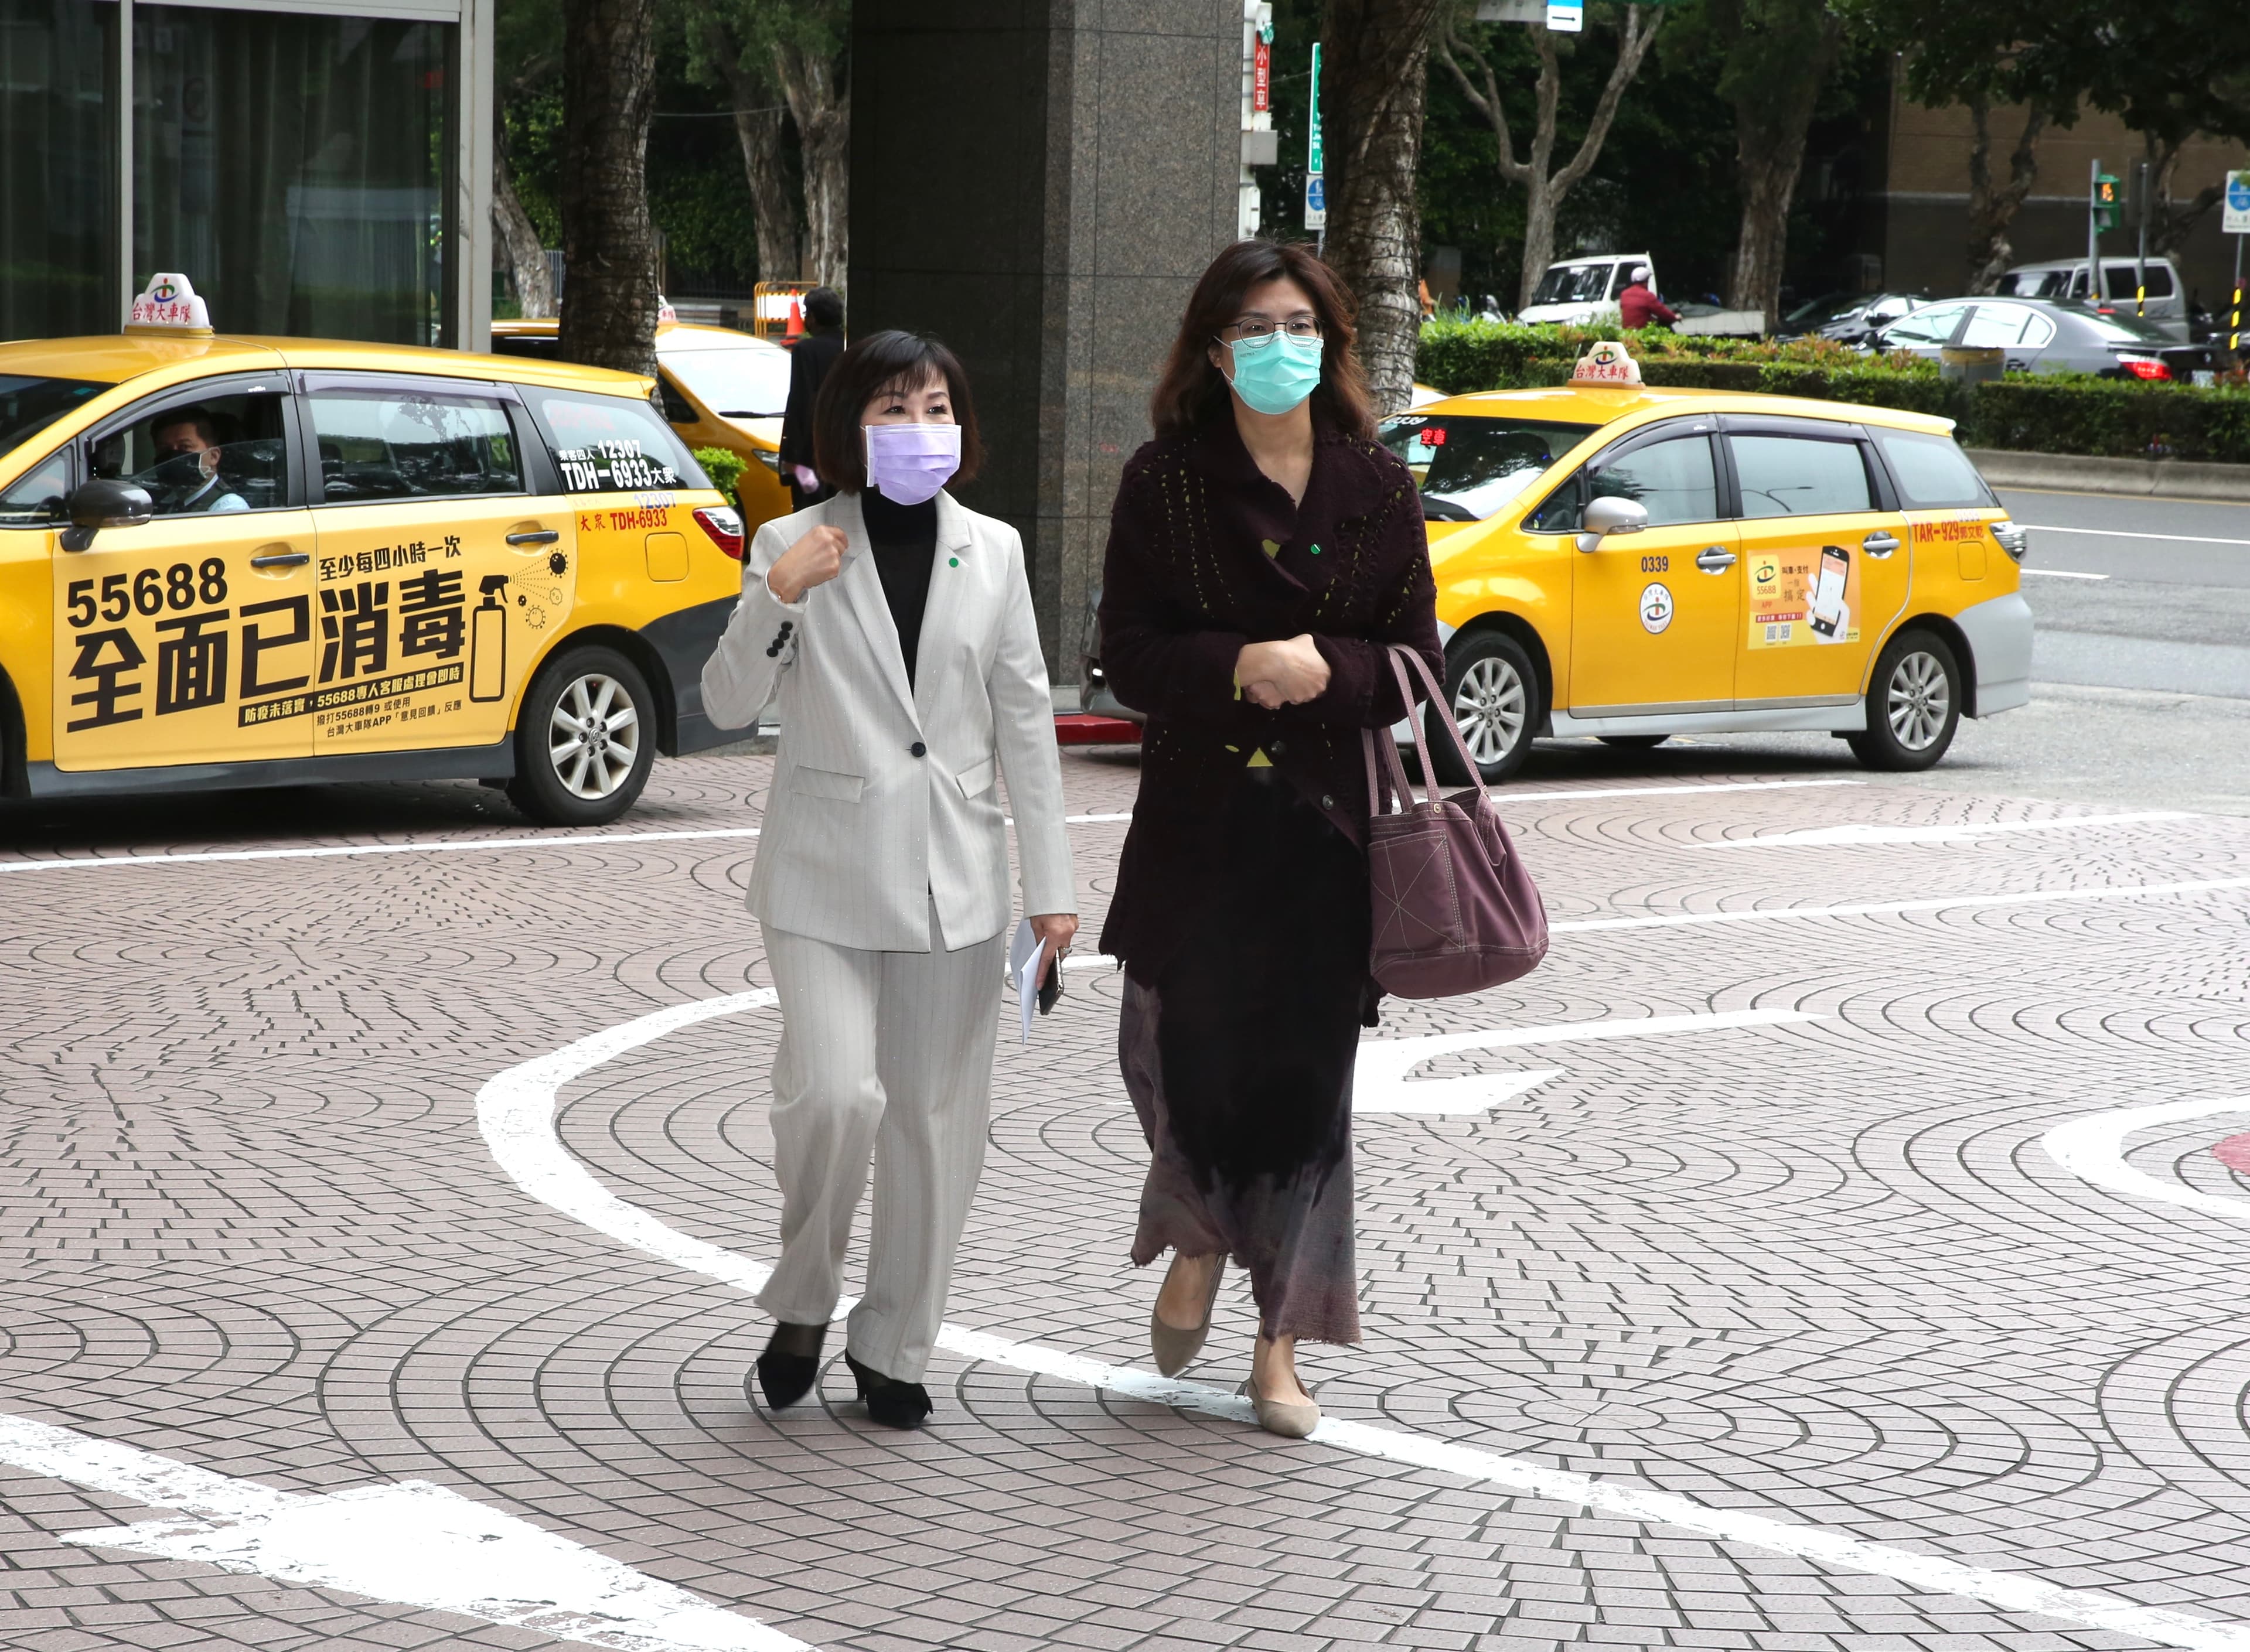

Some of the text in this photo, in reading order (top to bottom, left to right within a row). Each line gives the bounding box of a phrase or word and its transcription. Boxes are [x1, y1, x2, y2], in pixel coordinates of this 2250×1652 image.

[1256, 45, 1266, 108] 小型車
[132, 302, 191, 322] 台灣大車隊
[1576, 365, 1628, 380] 台灣大車隊
[1421, 428, 1446, 445] 空車
[559, 439, 641, 461] 乘客四人 12307
[560, 459, 652, 490] TDH-6933
[635, 493, 676, 509] 12307
[610, 508, 667, 531] TDH-6933
[319, 535, 462, 581] 至少每四小時一次
[1641, 556, 1668, 572] 0339
[67, 557, 228, 627] 55688
[1757, 585, 1776, 595] 55688
[67, 569, 465, 733] 全面已消毒
[384, 697, 411, 712] 或使用
